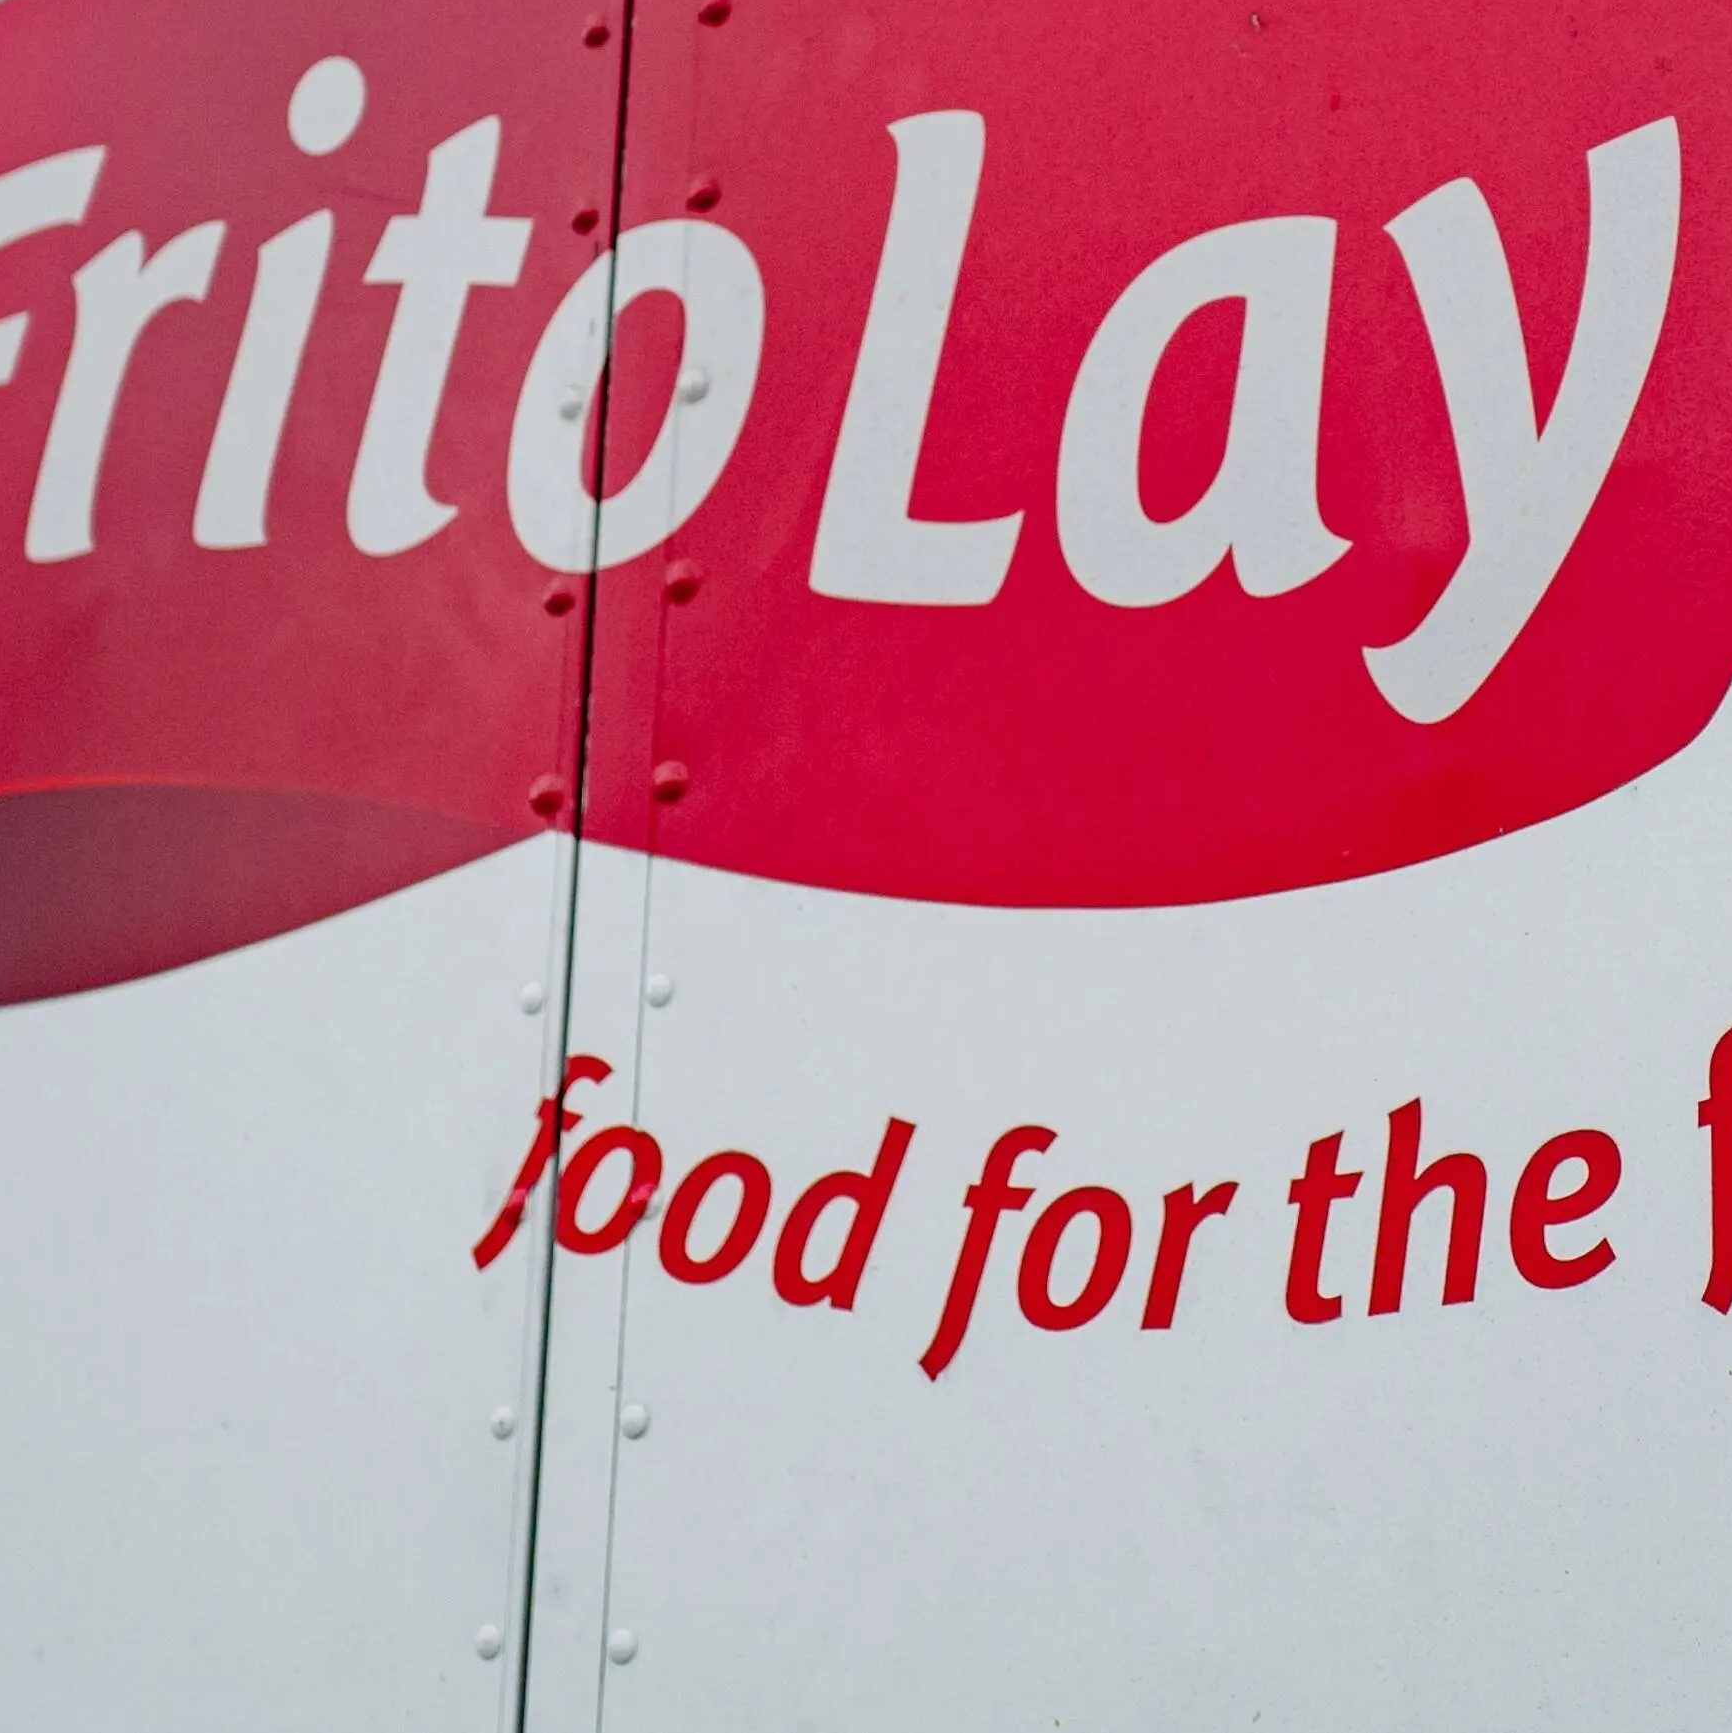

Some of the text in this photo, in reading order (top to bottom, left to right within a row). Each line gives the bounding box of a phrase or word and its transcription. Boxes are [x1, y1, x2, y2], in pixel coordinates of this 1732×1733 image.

[471, 1052, 916, 1312] food
[918, 1123, 1237, 1383] for
[1285, 1097, 1623, 1326] the
